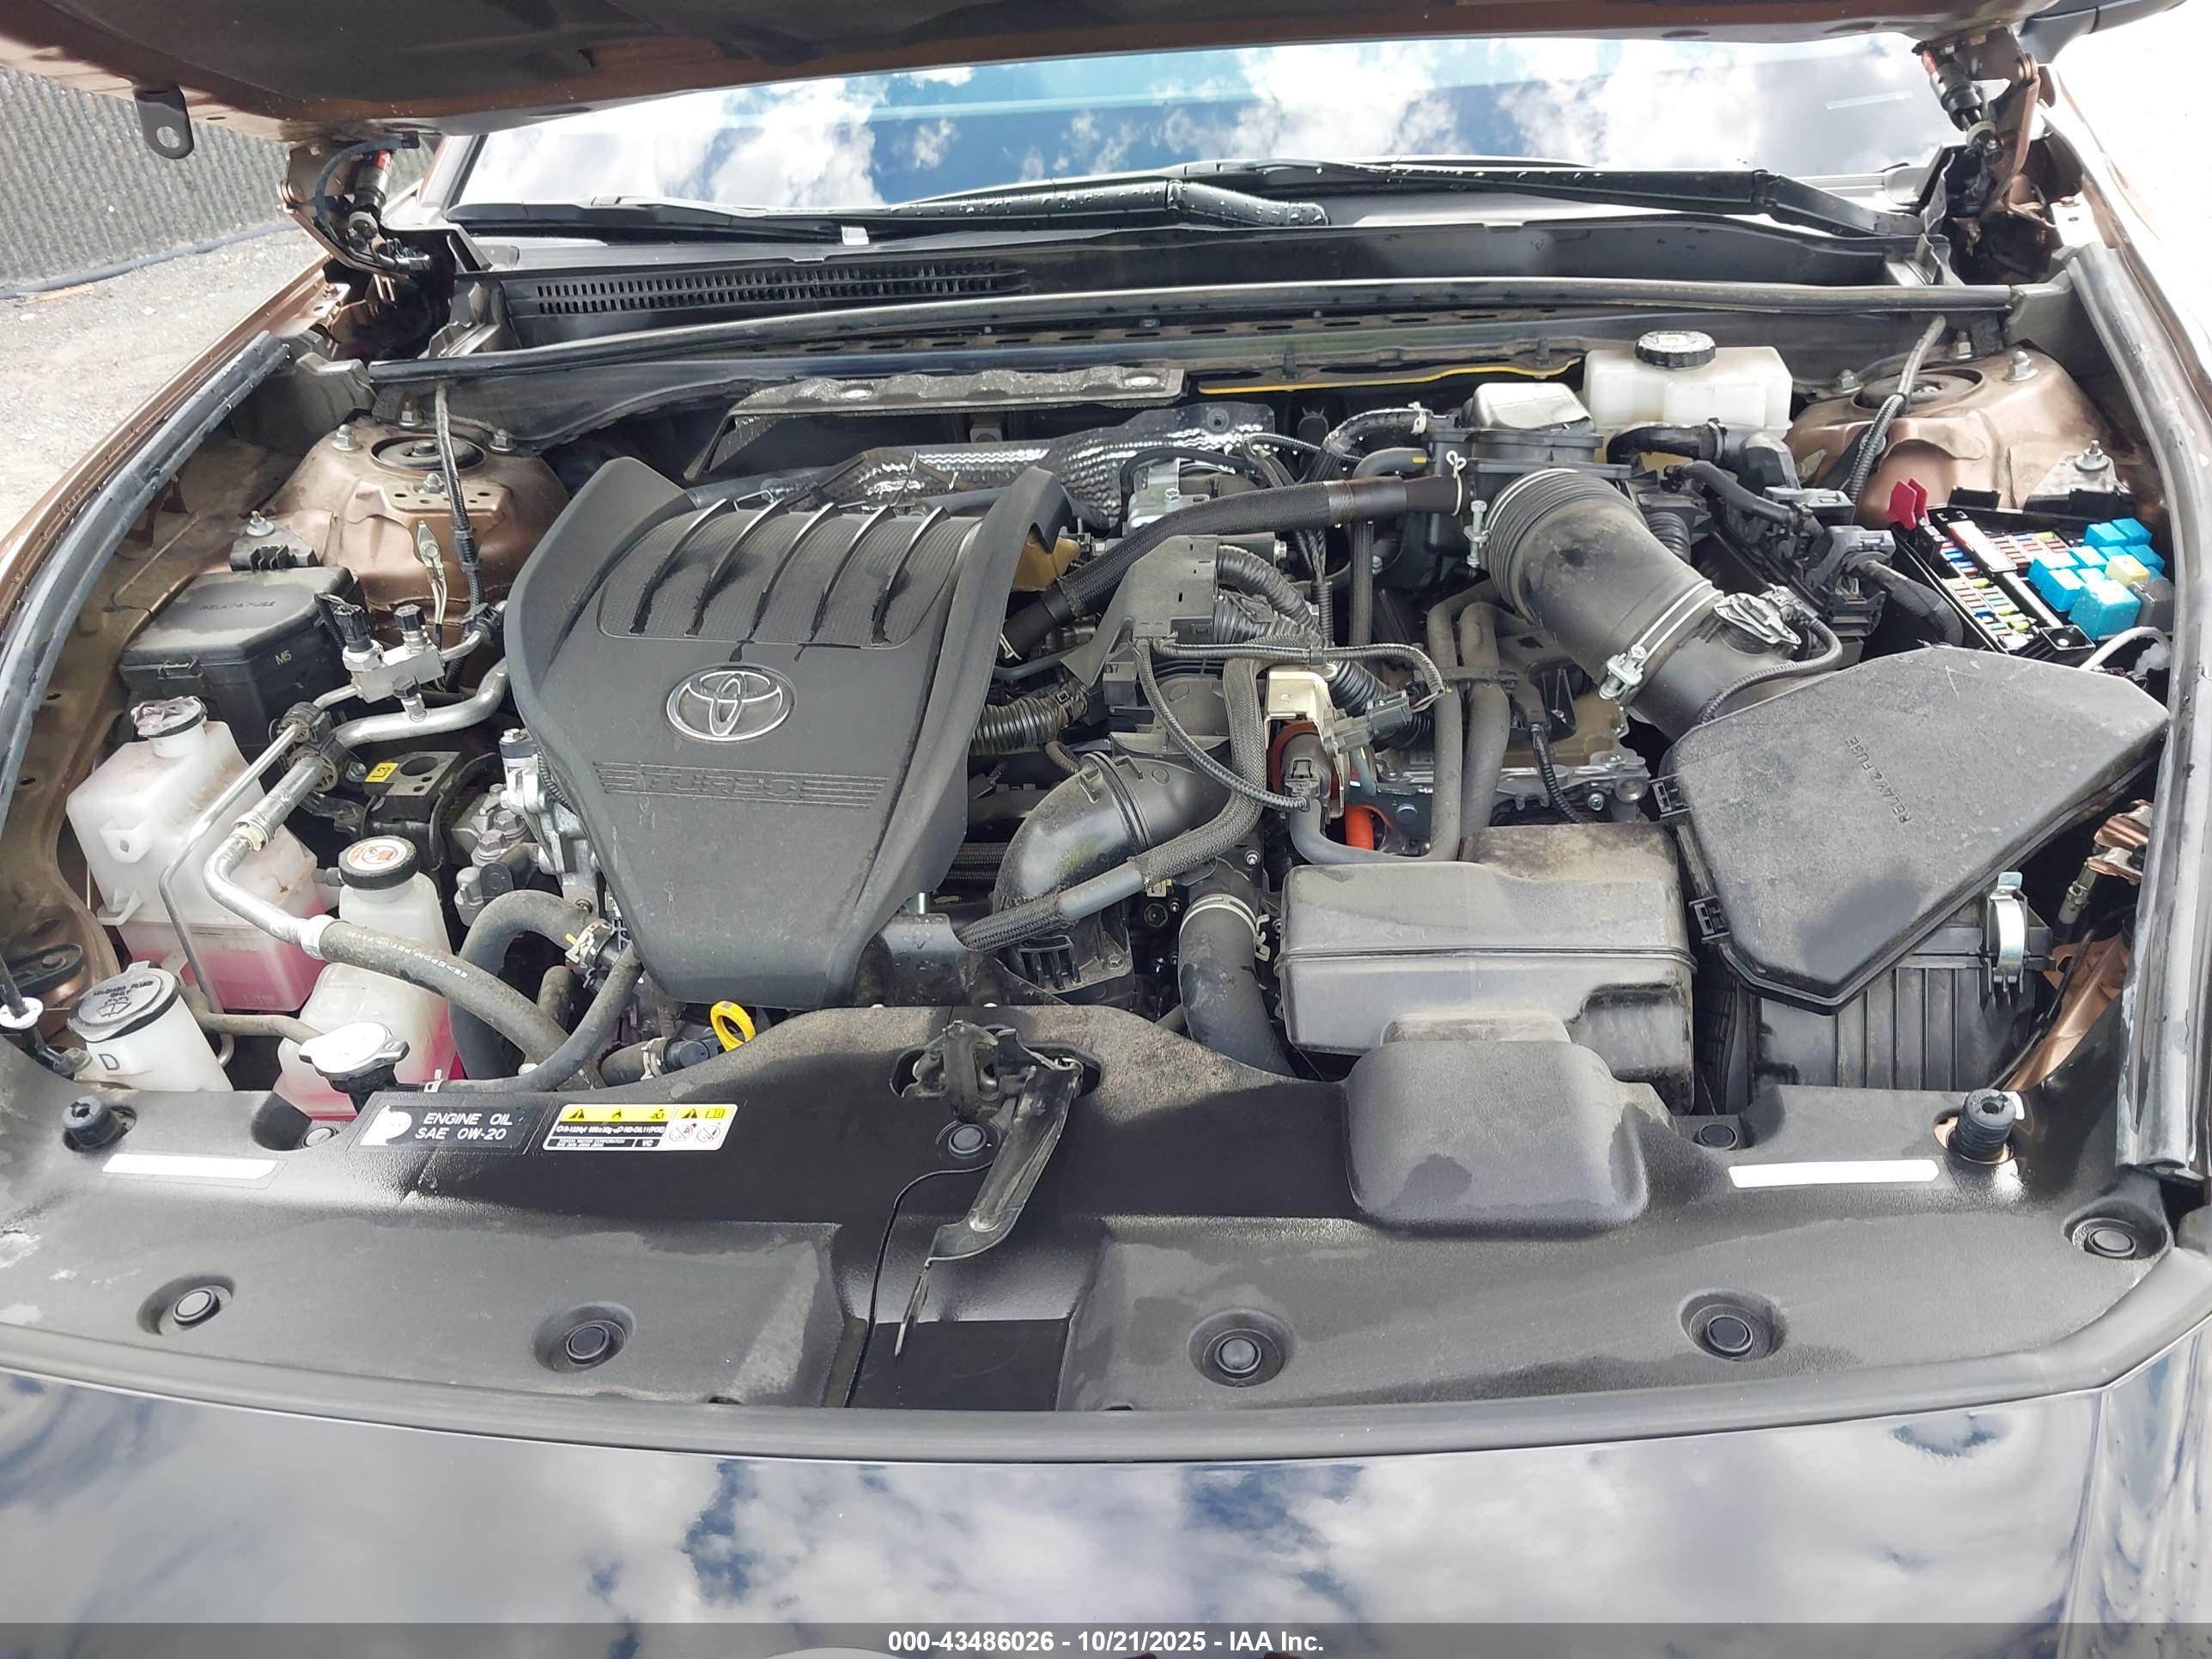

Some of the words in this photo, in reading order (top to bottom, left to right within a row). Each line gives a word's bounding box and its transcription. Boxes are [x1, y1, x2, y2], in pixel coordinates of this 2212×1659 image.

[1844, 736, 1876, 770] FUSE
[1875, 782, 1912, 823] RELAY
[422, 1112, 483, 1126] ENGINE
[489, 1113, 514, 1127] OIL
[415, 1127, 450, 1140] SAE
[456, 1127, 507, 1141] 0W-20
